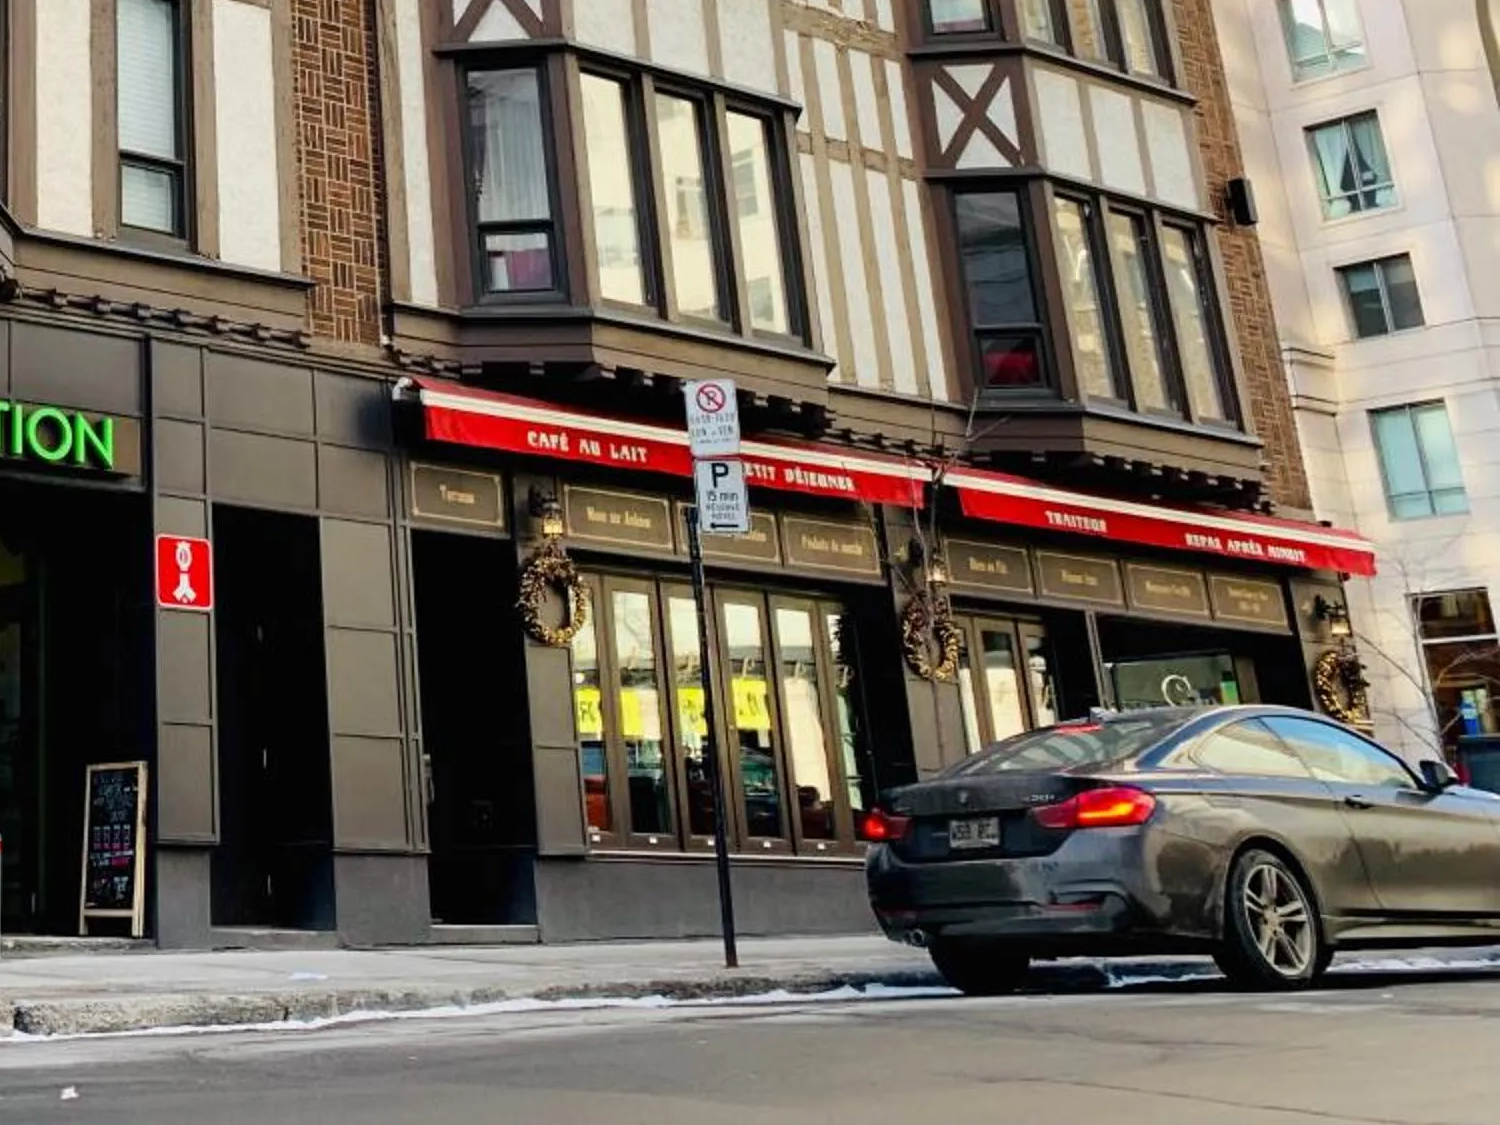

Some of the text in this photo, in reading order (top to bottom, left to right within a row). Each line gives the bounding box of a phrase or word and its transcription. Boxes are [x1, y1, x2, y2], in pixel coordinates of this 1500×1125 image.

[526, 430, 647, 463] CAFÉ AU LAIT
[711, 463, 729, 488] P
[741, 462, 776, 481] ETIT
